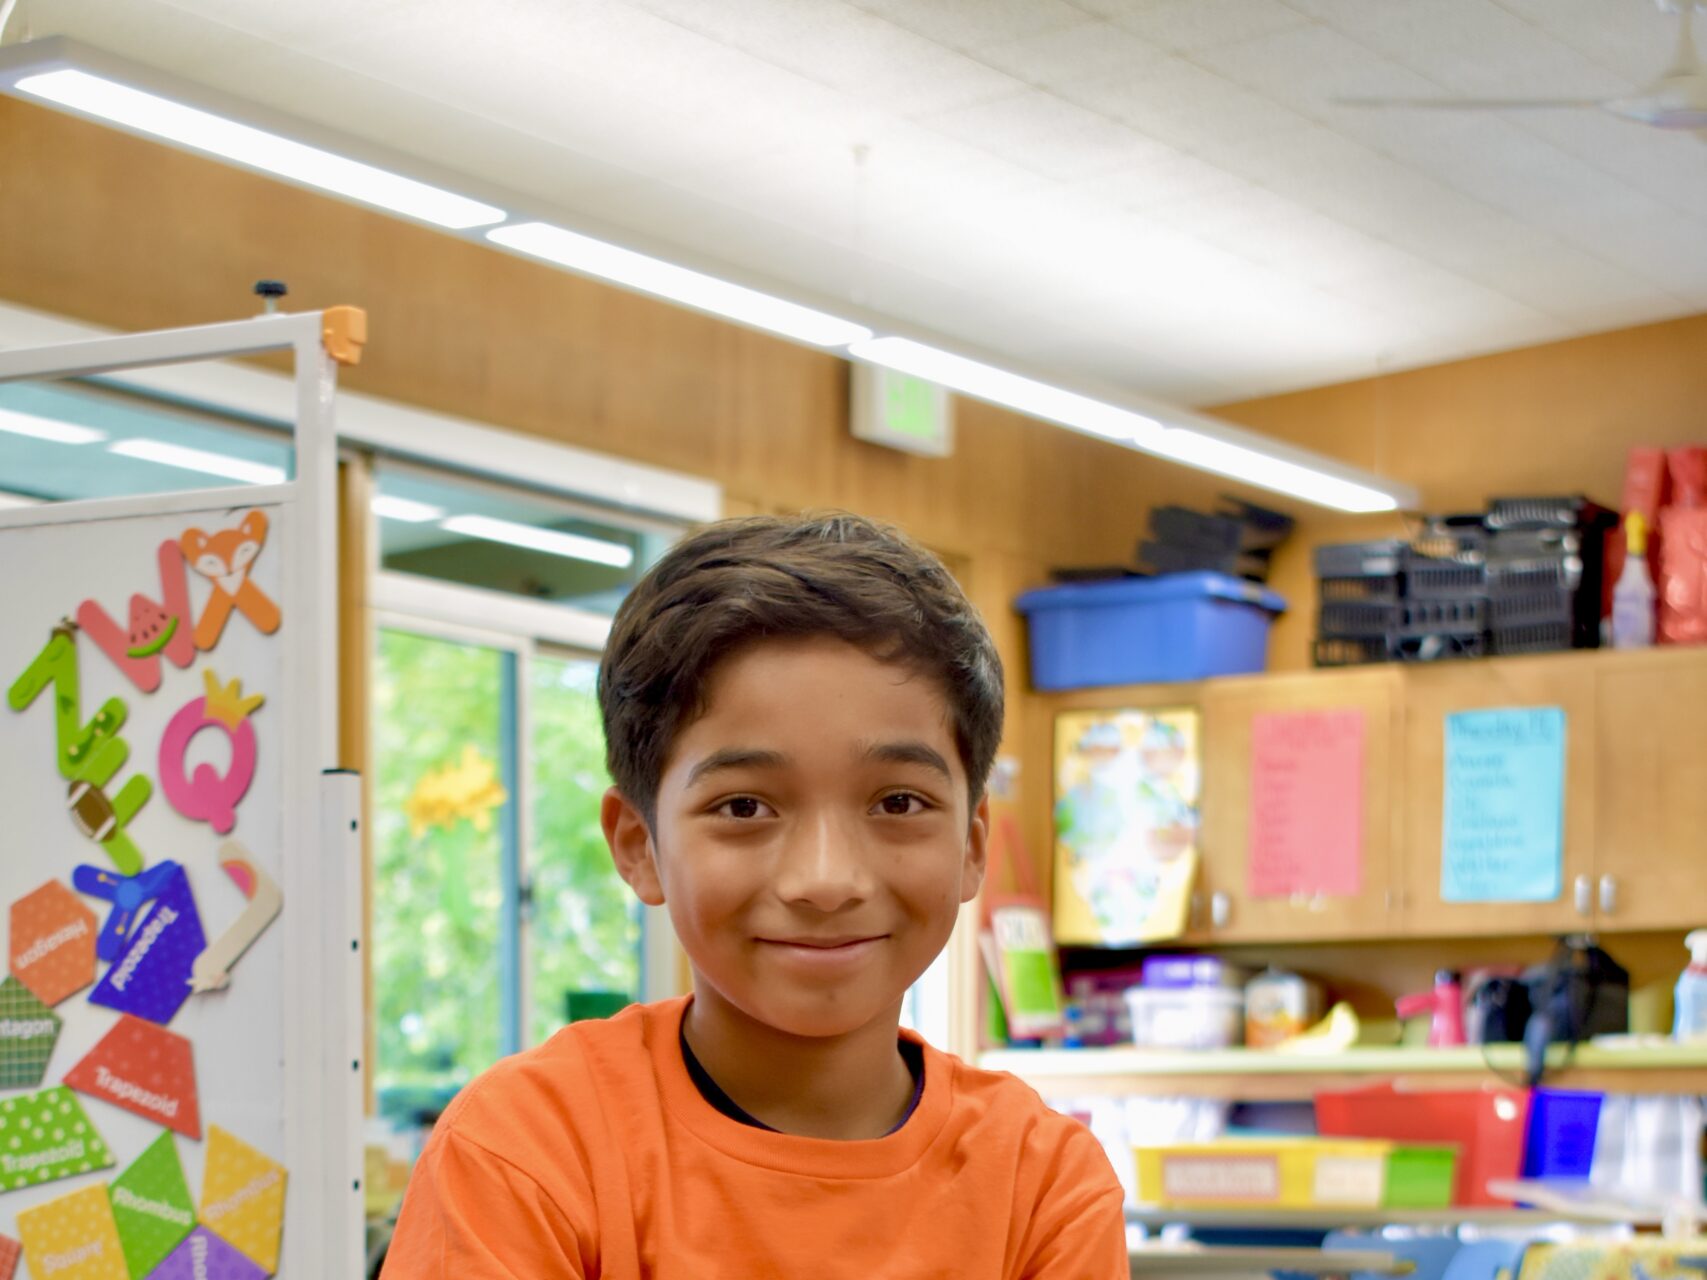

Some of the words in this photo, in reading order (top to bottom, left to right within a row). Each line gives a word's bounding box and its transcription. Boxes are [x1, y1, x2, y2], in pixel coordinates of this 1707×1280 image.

[95, 1065, 179, 1117] Trapezoid
[2, 1139, 84, 1173] Trapezoid
[113, 1186, 192, 1226] Rhombus
